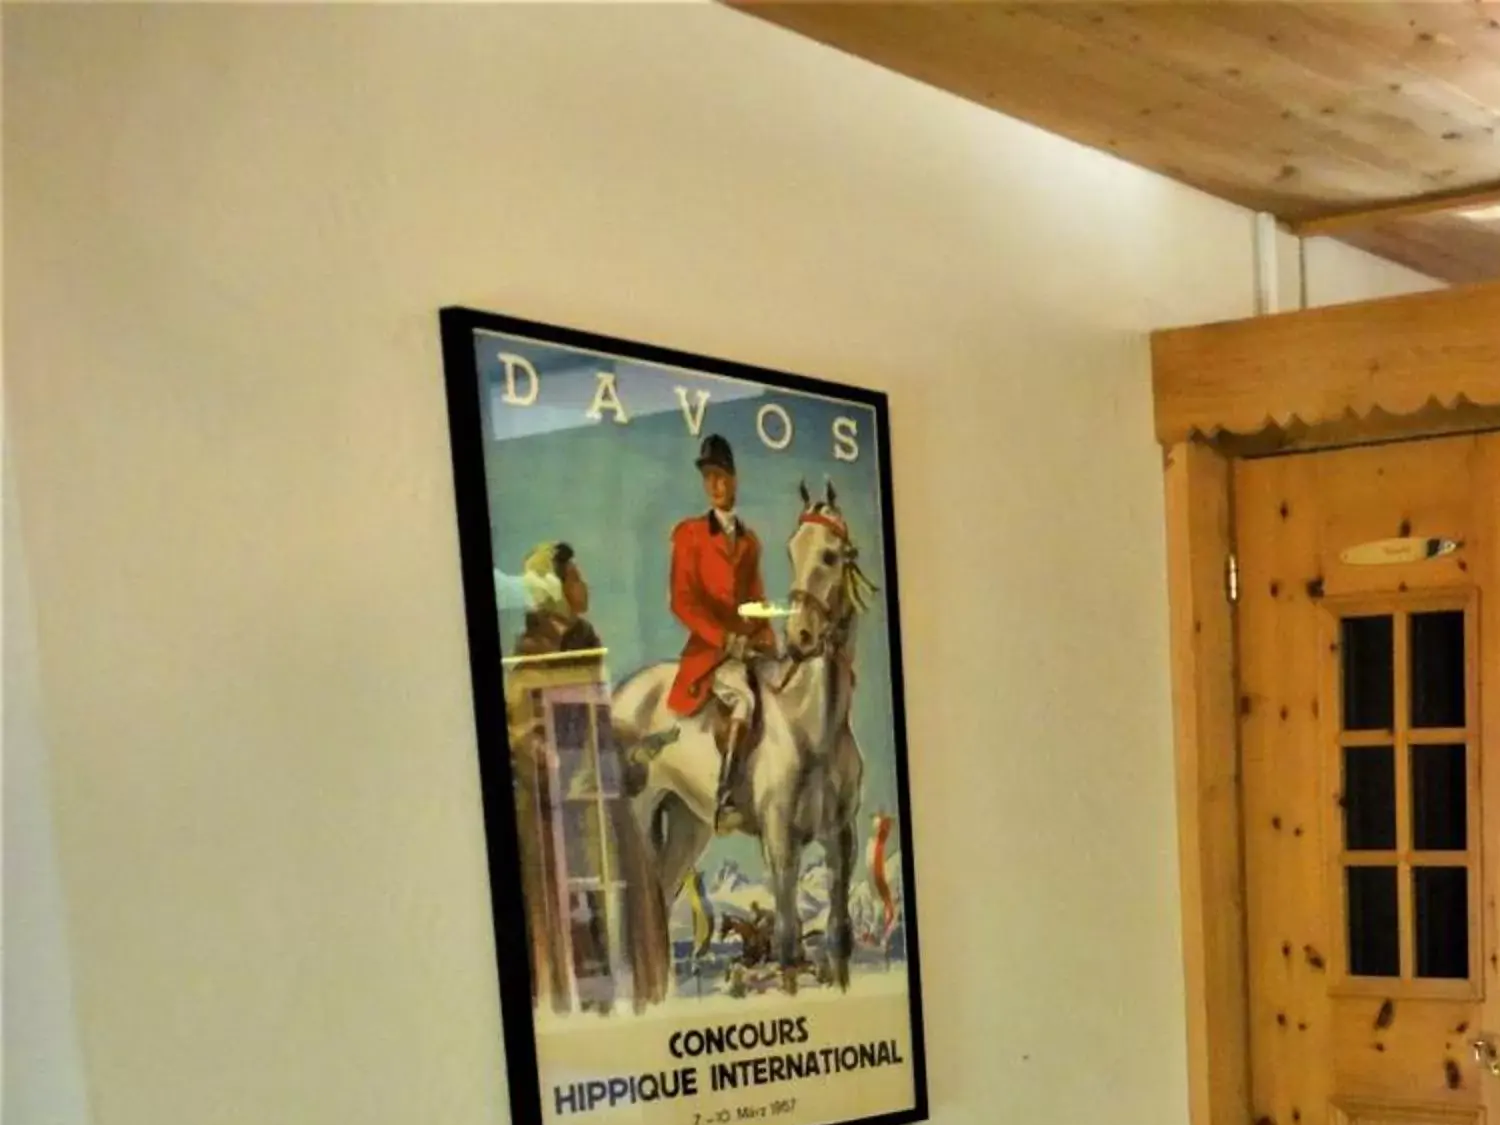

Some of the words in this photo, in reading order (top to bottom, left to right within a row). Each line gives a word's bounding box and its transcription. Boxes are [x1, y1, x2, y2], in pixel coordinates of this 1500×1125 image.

[498, 353, 860, 462] DAVOS
[669, 1016, 809, 1058] CONCOURS
[554, 1067, 698, 1115] HIPPIQUE
[710, 1039, 903, 1092] INTERNATIONAL
